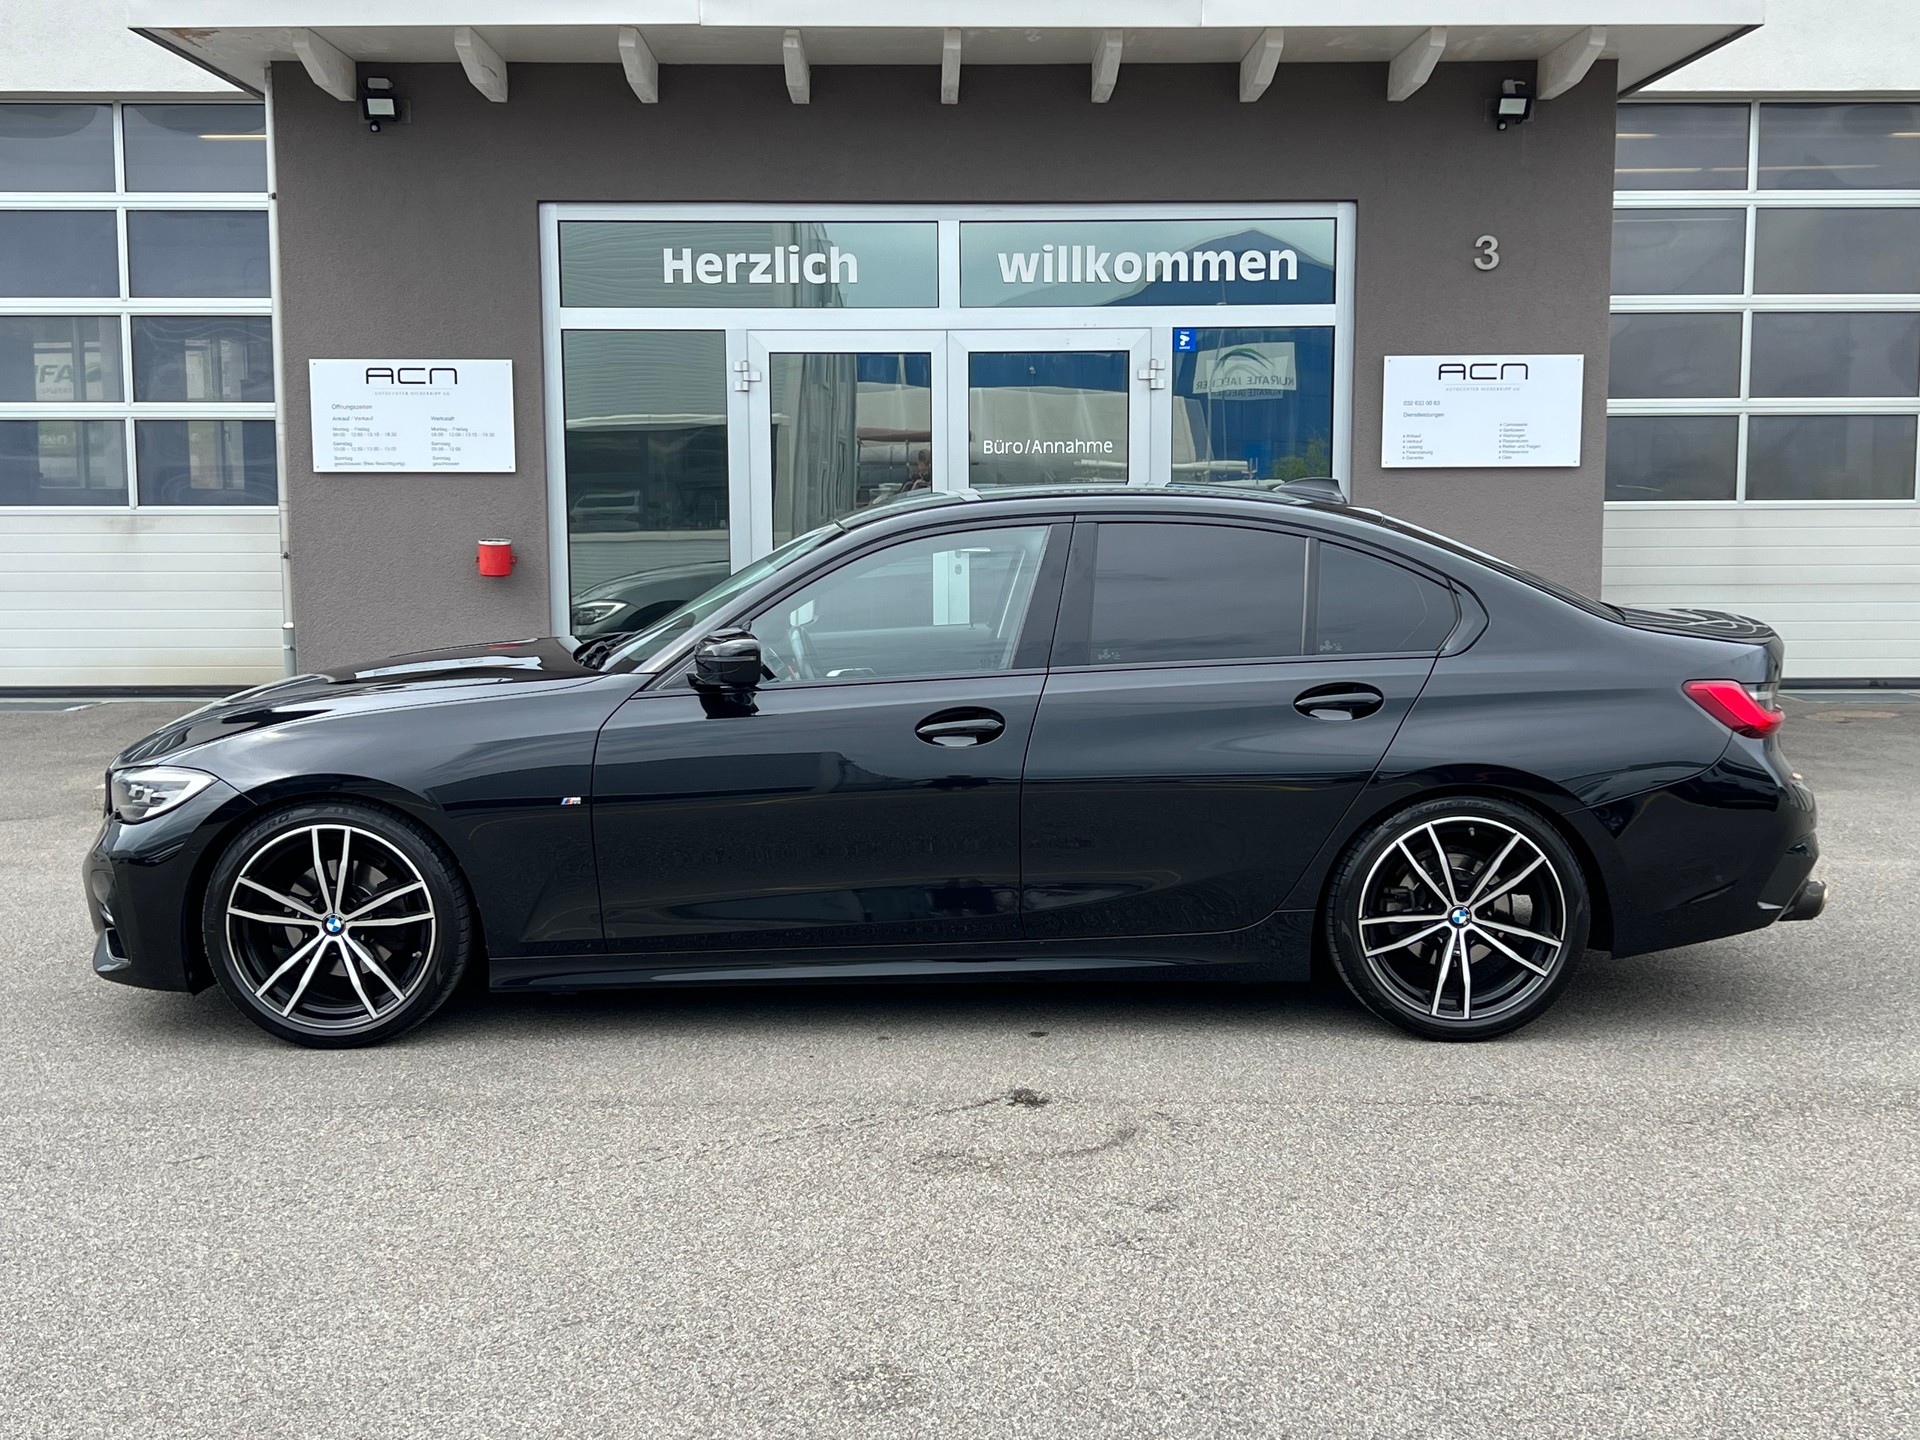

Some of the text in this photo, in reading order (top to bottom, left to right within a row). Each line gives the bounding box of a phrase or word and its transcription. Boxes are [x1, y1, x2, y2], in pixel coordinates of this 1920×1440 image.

[1474, 234, 1500, 270] 3
[661, 243, 1299, 285] Herzlich willkommen
[365, 367, 458, 385] ACN
[1437, 363, 1529, 381] ACN
[983, 438, 1113, 454] Büro/Annahme
